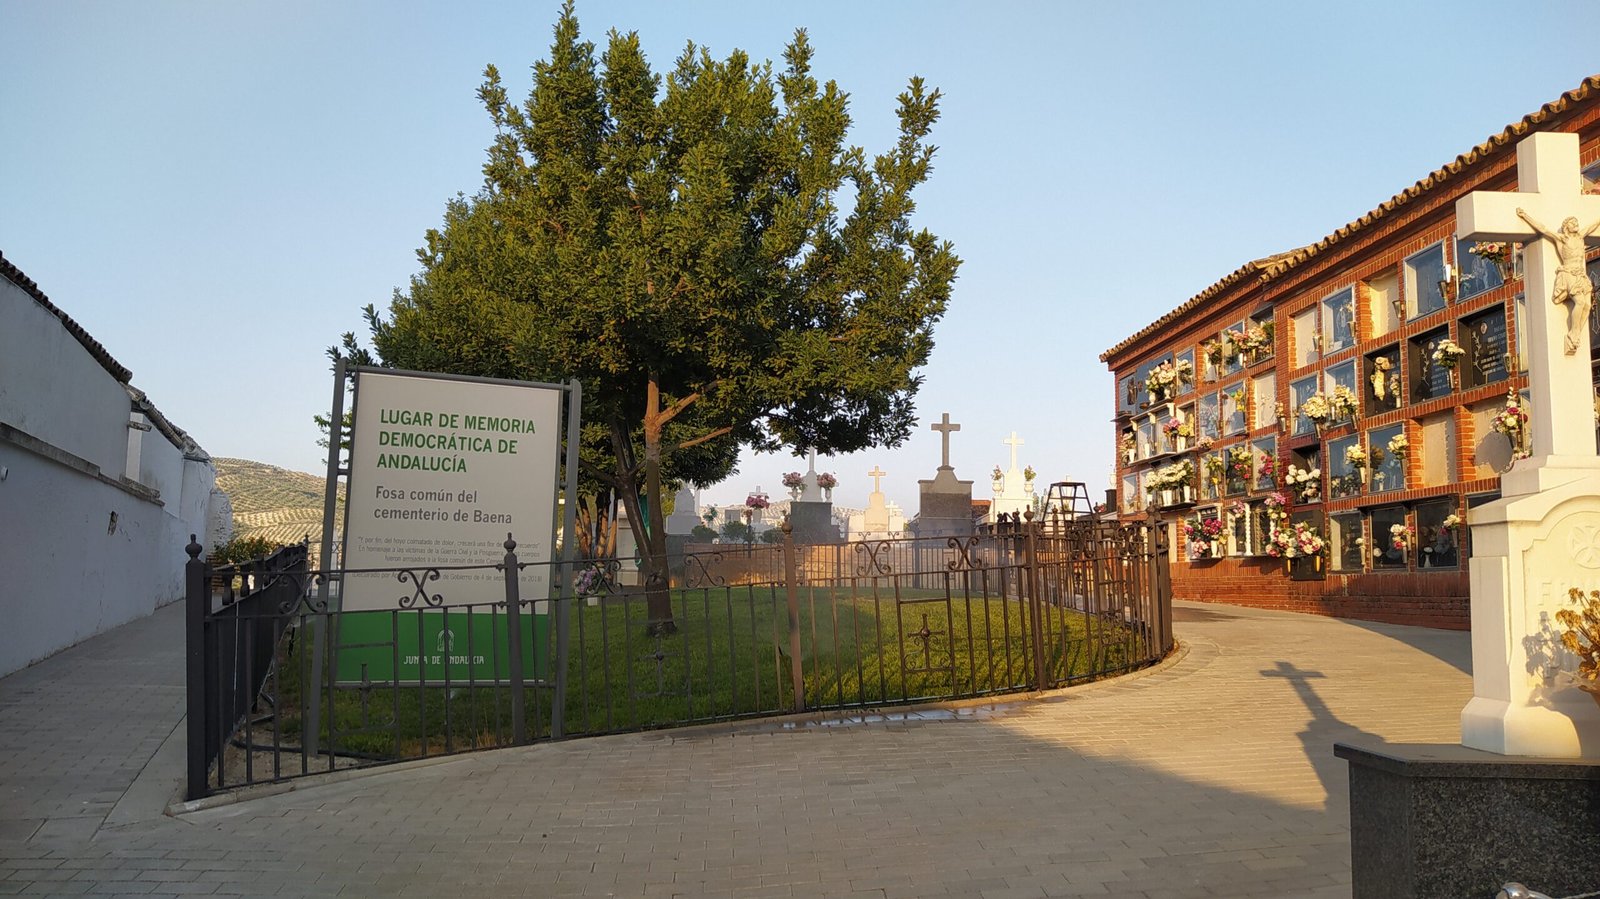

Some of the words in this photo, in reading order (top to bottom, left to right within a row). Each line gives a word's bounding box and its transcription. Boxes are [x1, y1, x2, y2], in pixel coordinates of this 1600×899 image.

[380, 408, 433, 426] LUGAR
[438, 413, 460, 428] DE
[464, 415, 536, 434] MEMORIA
[379, 431, 492, 453] DEMOCRÁTICA
[498, 439, 518, 454] DE
[377, 454, 467, 472] ANDALUCÍA
[376, 486, 405, 500] Fosa
[410, 488, 453, 502] común
[458, 490, 478, 504] del
[374, 507, 449, 522] cementerio
[453, 509, 469, 522] de
[474, 510, 512, 524] Baena
[431, 656, 441, 664] DE
